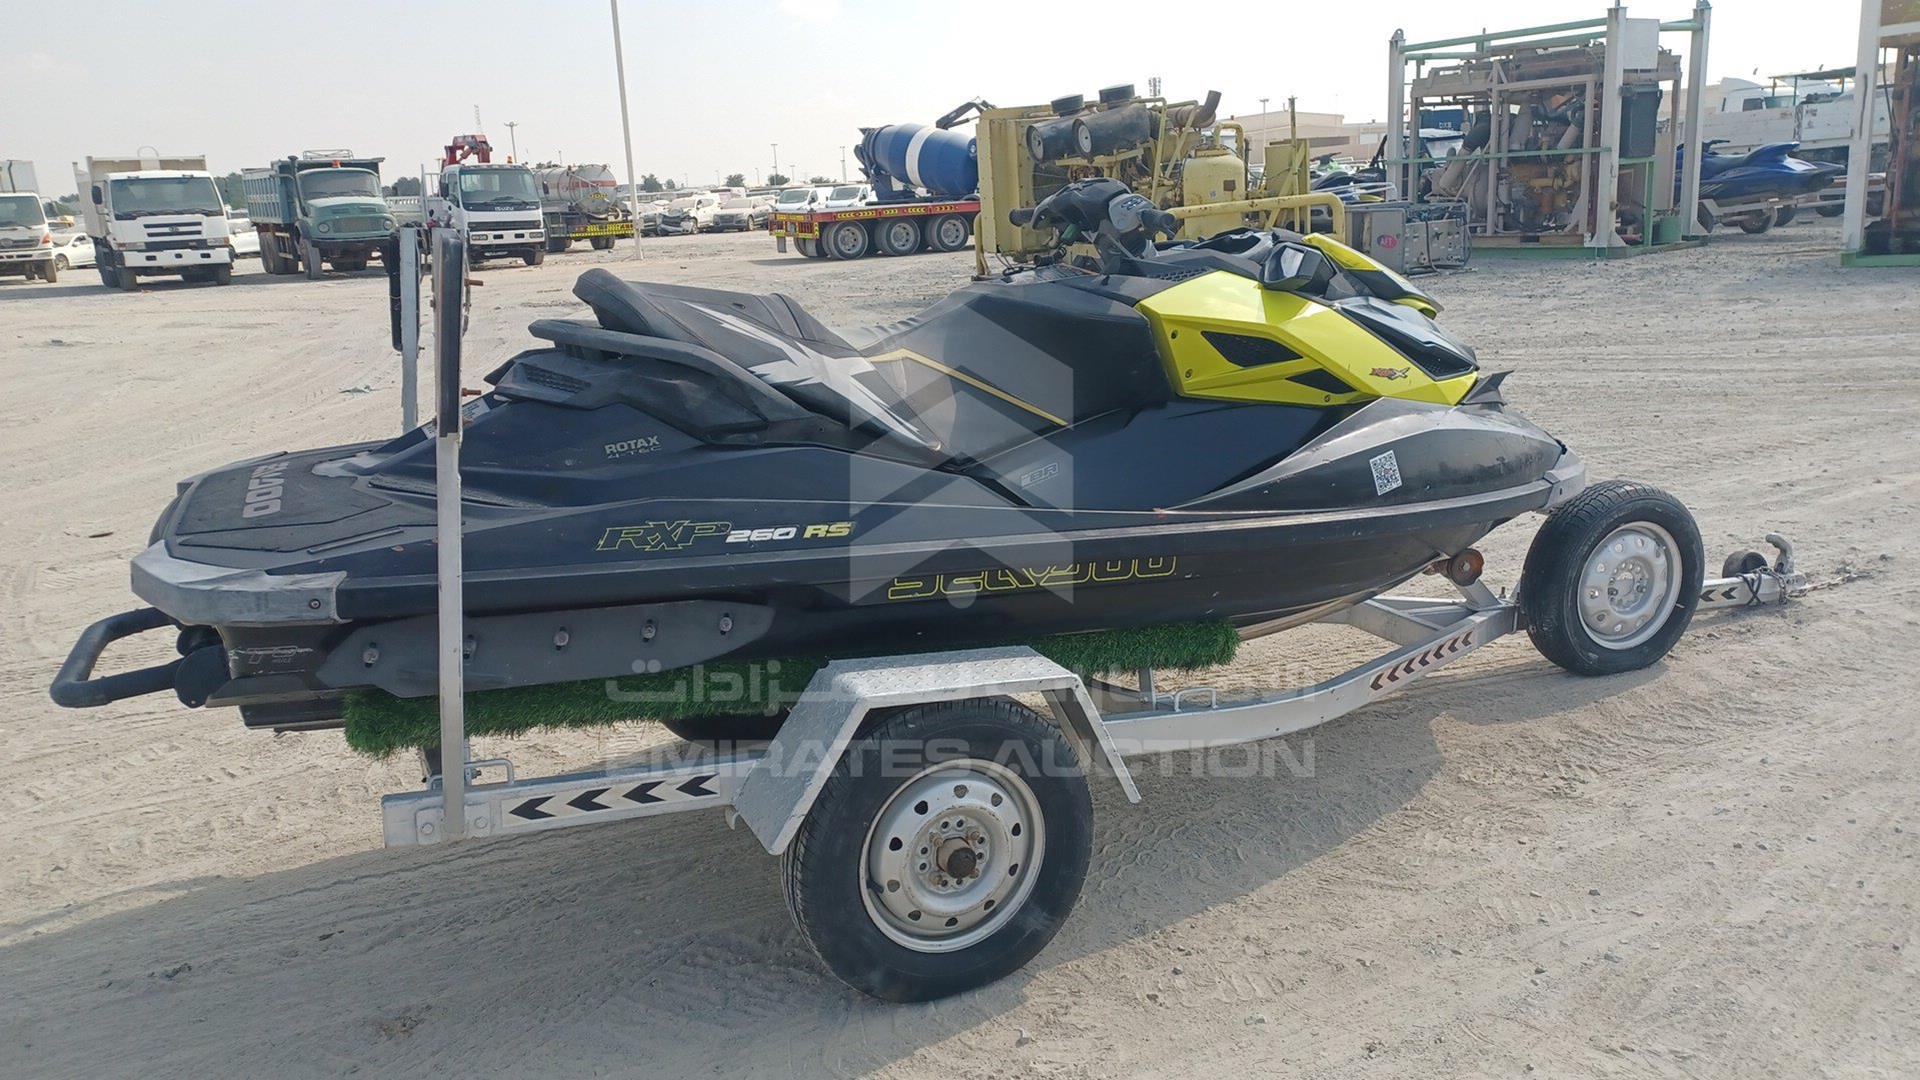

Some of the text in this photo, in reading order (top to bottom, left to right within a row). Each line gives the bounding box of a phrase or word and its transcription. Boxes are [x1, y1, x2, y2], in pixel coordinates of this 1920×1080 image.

[605, 435, 660, 455] ROTAX
[596, 520, 856, 552] RXP 260 RS
